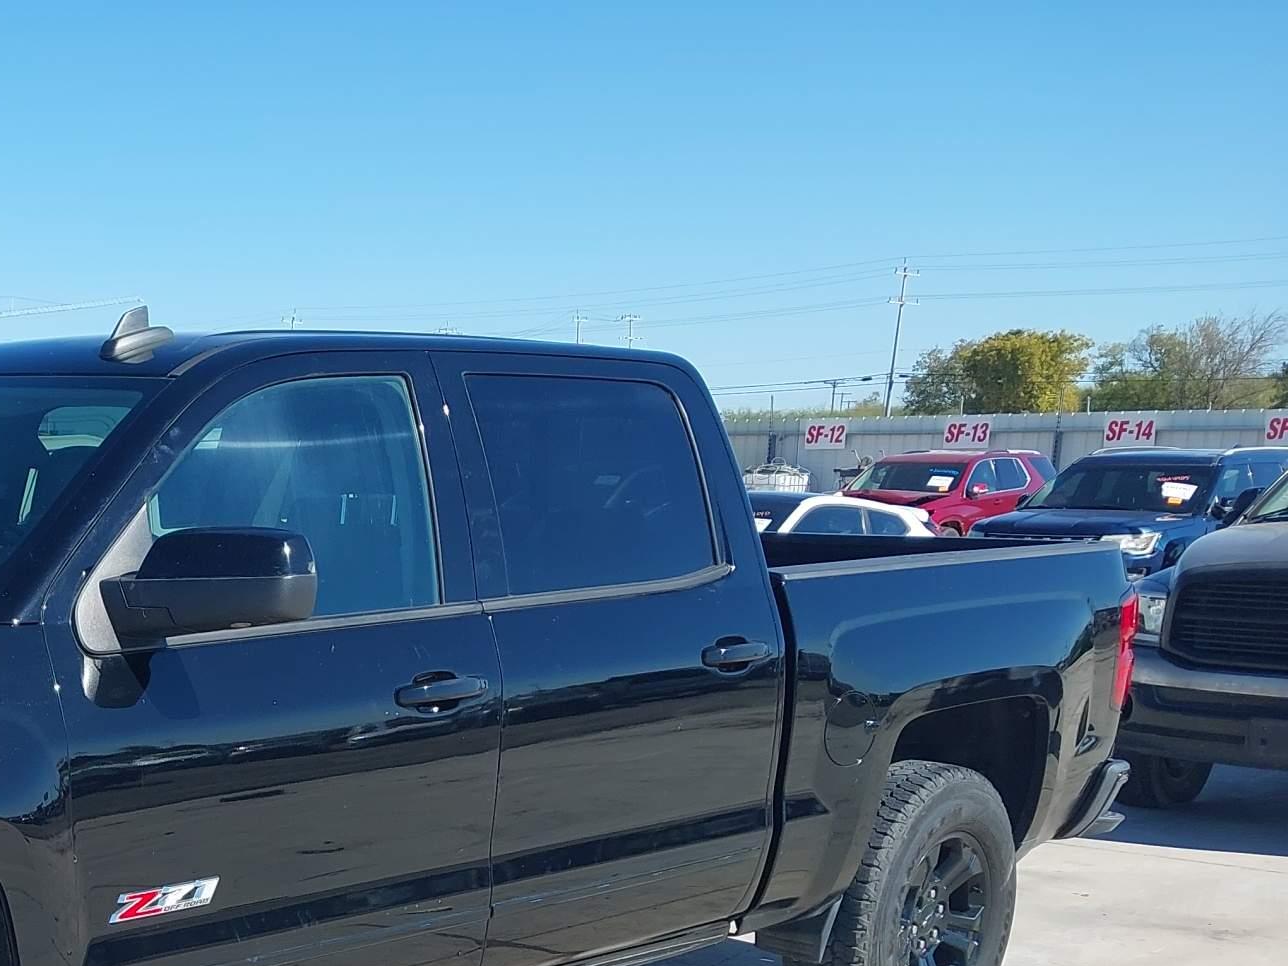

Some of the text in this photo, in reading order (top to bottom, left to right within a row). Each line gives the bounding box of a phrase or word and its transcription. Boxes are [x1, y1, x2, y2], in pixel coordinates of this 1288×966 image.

[806, 425, 845, 444] SF-12
[945, 423, 989, 443] SF-13
[1106, 420, 1154, 441] SF-14
[109, 875, 220, 924] Z71
